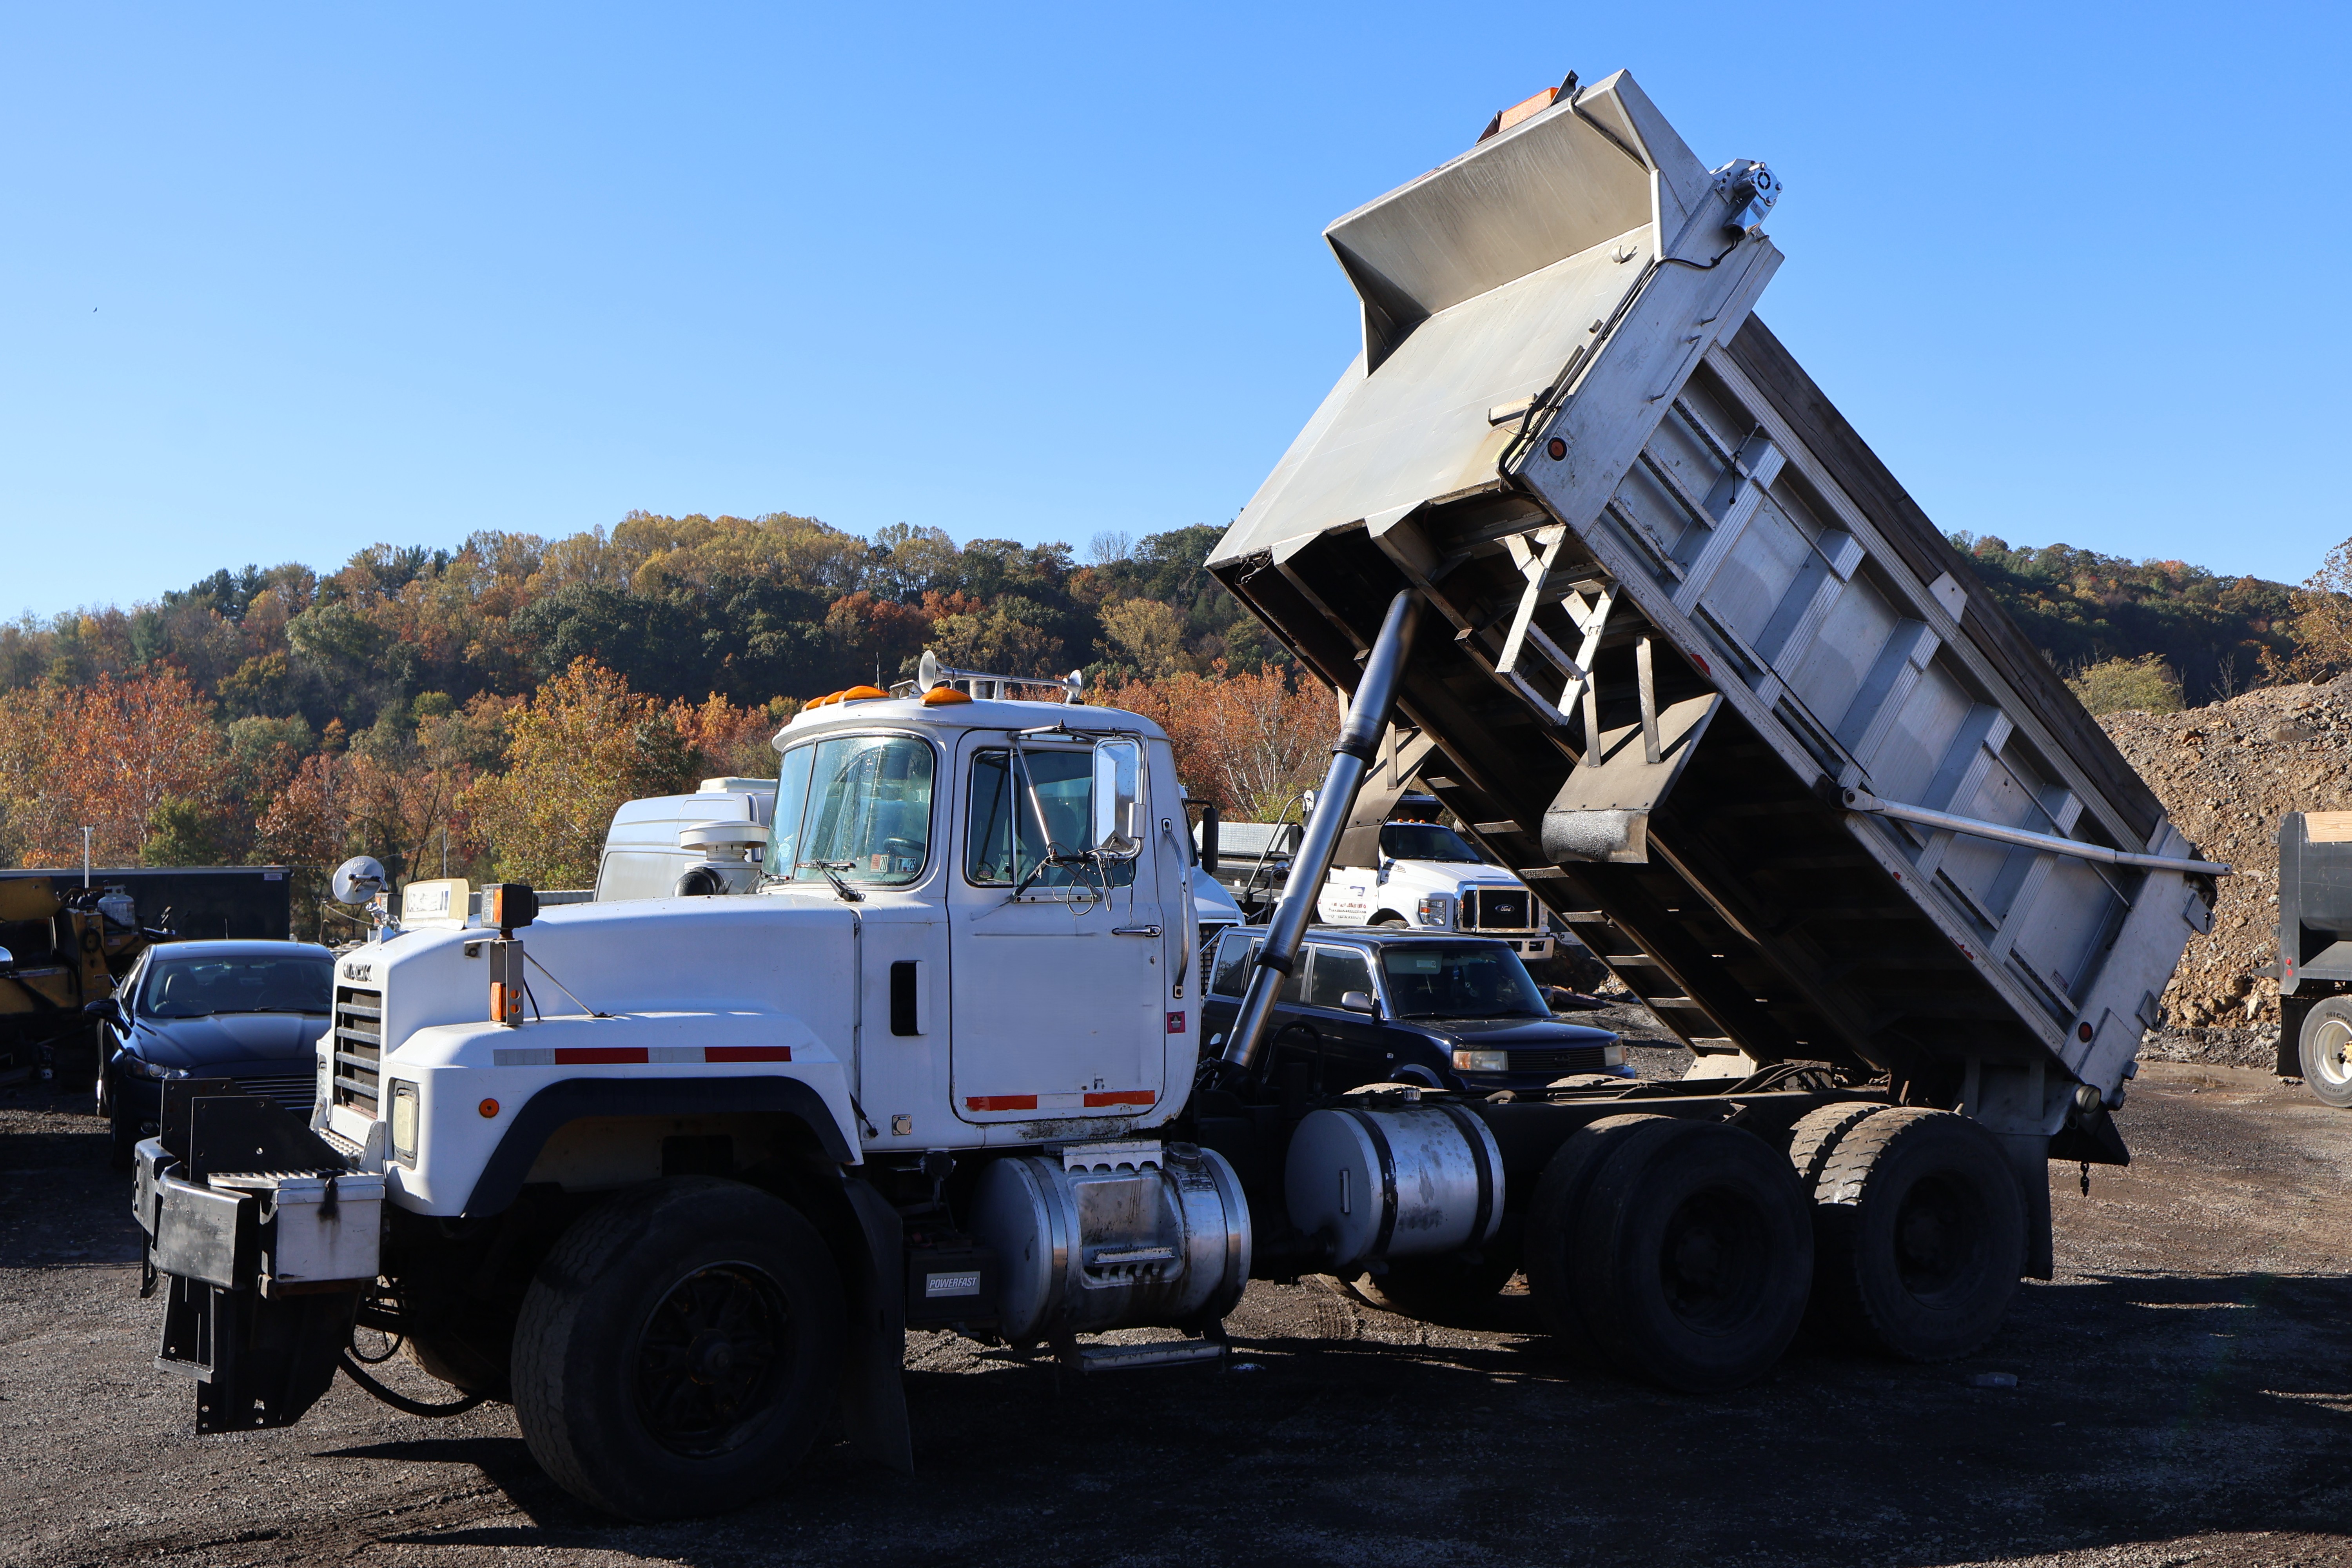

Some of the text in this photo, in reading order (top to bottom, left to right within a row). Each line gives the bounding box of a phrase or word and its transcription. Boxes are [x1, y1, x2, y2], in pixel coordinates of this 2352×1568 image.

[880, 857, 887, 871] 20
[909, 858, 916, 870] 25
[343, 962, 372, 982] MACK
[2326, 1012, 2352, 1028] MICHE
[929, 1277, 977, 1289] POWERFAST
